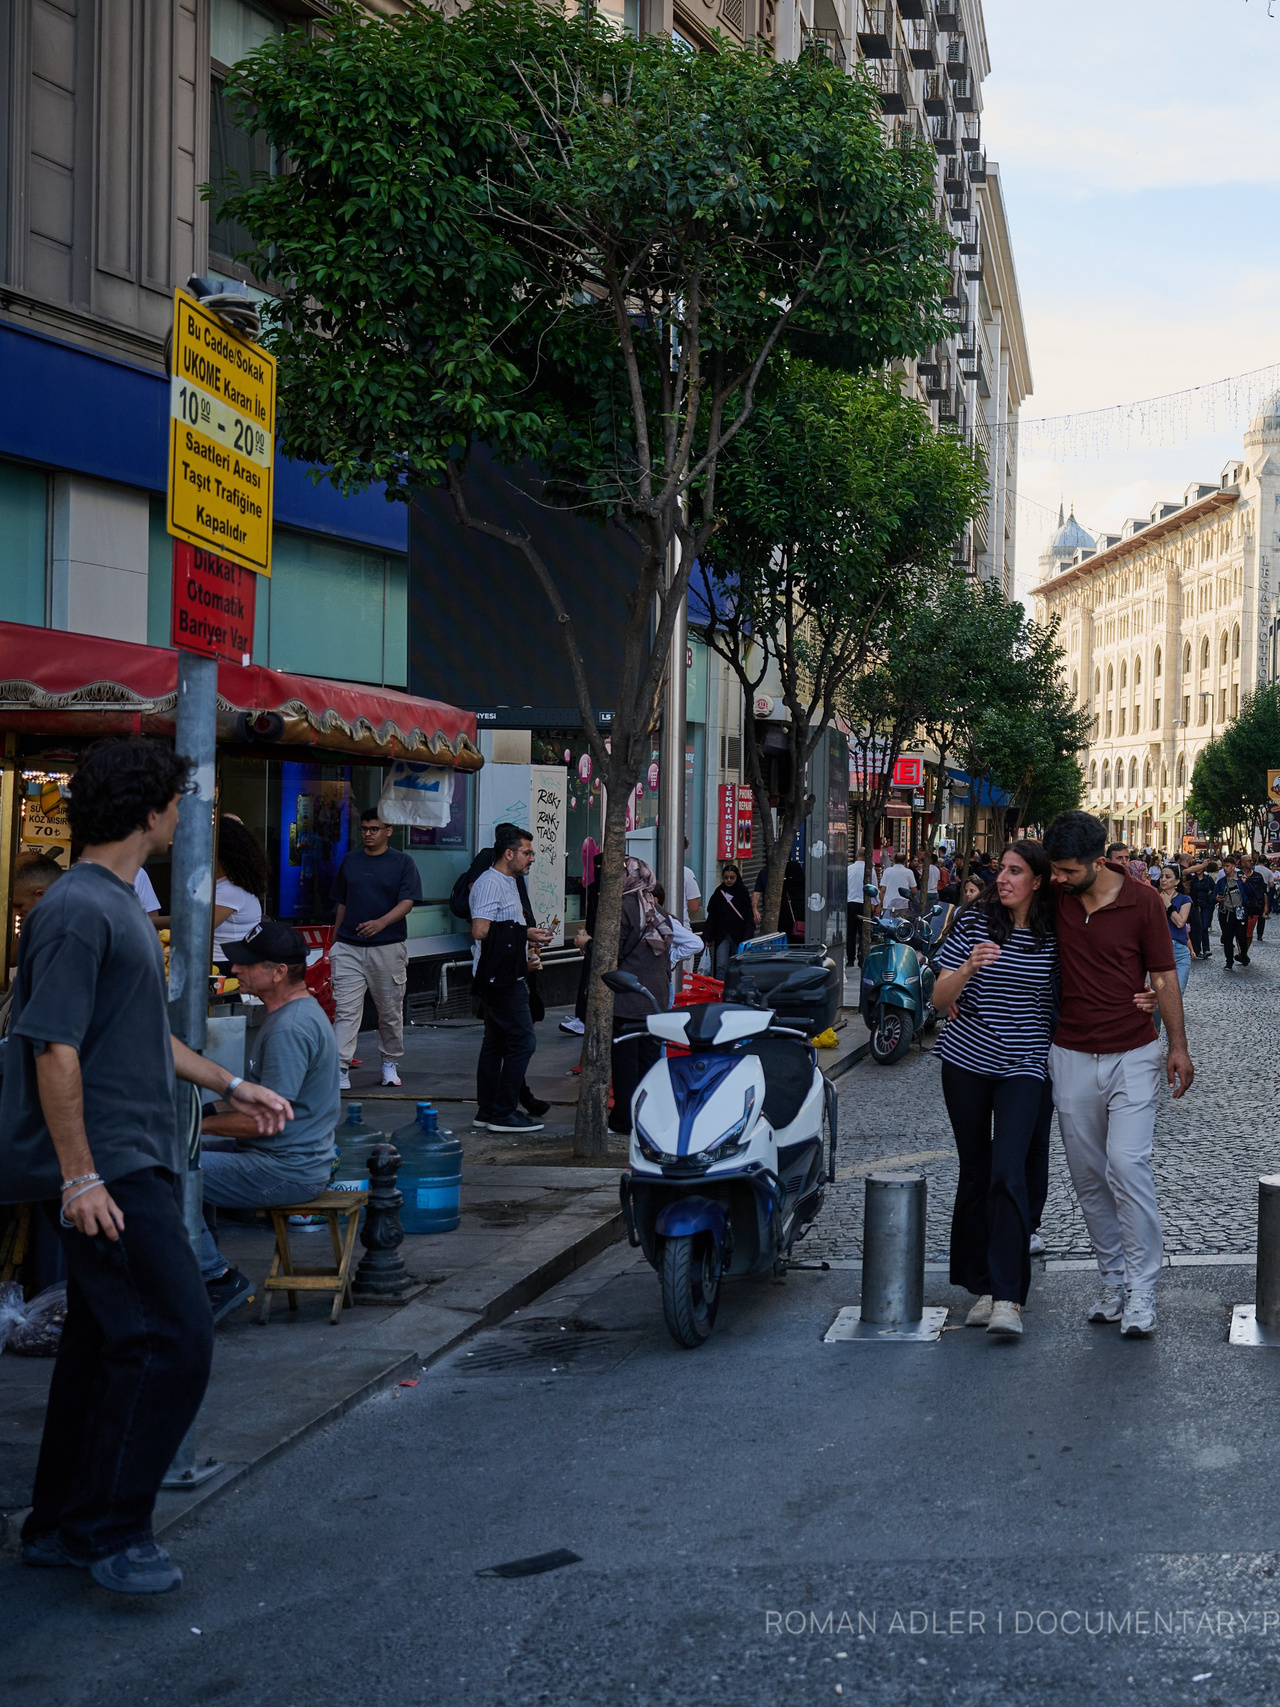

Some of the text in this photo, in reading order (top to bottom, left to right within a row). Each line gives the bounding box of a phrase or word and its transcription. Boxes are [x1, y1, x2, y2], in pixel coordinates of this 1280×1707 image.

[187, 314, 265, 385] Bu Cadde/Sokak
[183, 345, 221, 393] UKOME
[224, 378, 252, 413] Kararı
[185, 431, 261, 488] Saatleri Arası
[182, 461, 263, 519] Taşıt Trafiğine
[196, 504, 247, 544] Kapalıdır
[193, 547, 236, 585] Dikkat
[1260, 555, 1270, 626] LEGACY
[187, 579, 244, 620] Otomatik
[179, 609, 249, 652] Bariyer Var
